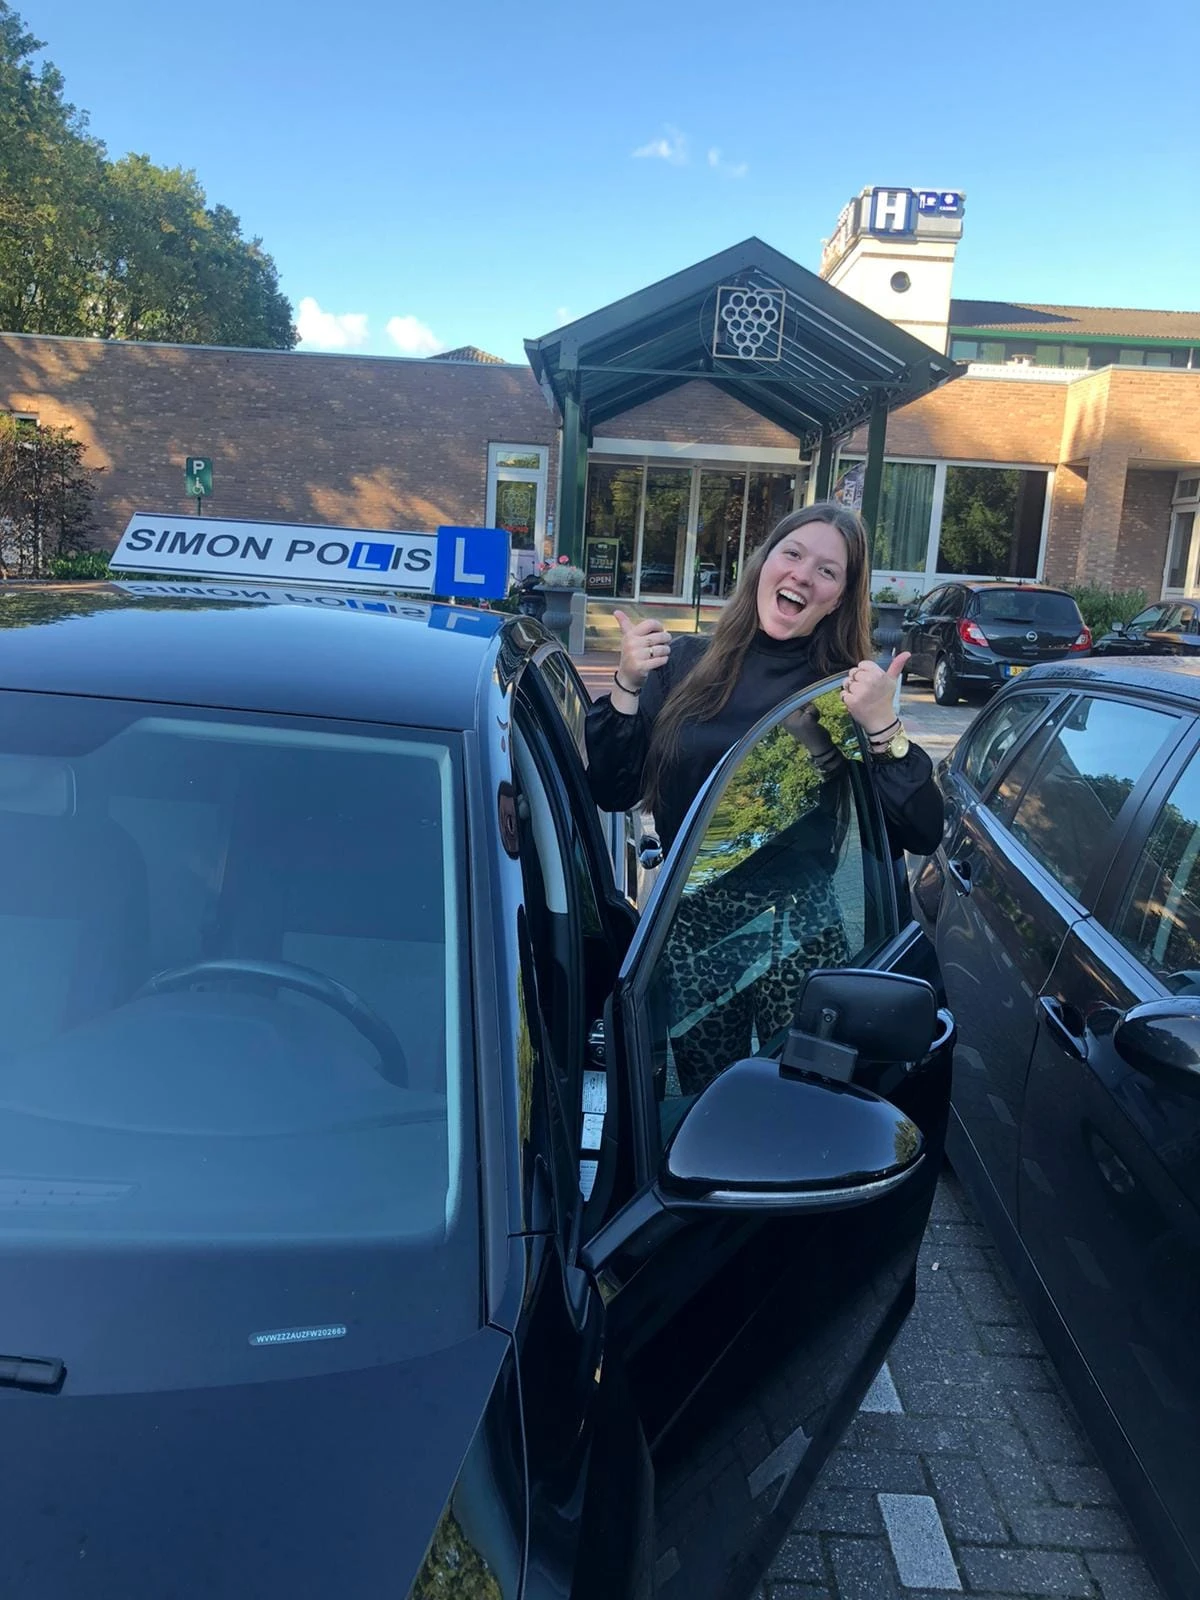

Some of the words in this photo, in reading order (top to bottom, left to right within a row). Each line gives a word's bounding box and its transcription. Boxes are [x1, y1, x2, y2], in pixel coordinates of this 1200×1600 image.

[875, 191, 907, 230] H
[192, 460, 205, 475] P
[126, 529, 273, 560] SIMON
[285, 540, 432, 573] POLIS
[454, 537, 486, 585] L
[589, 576, 612, 584] OPEN
